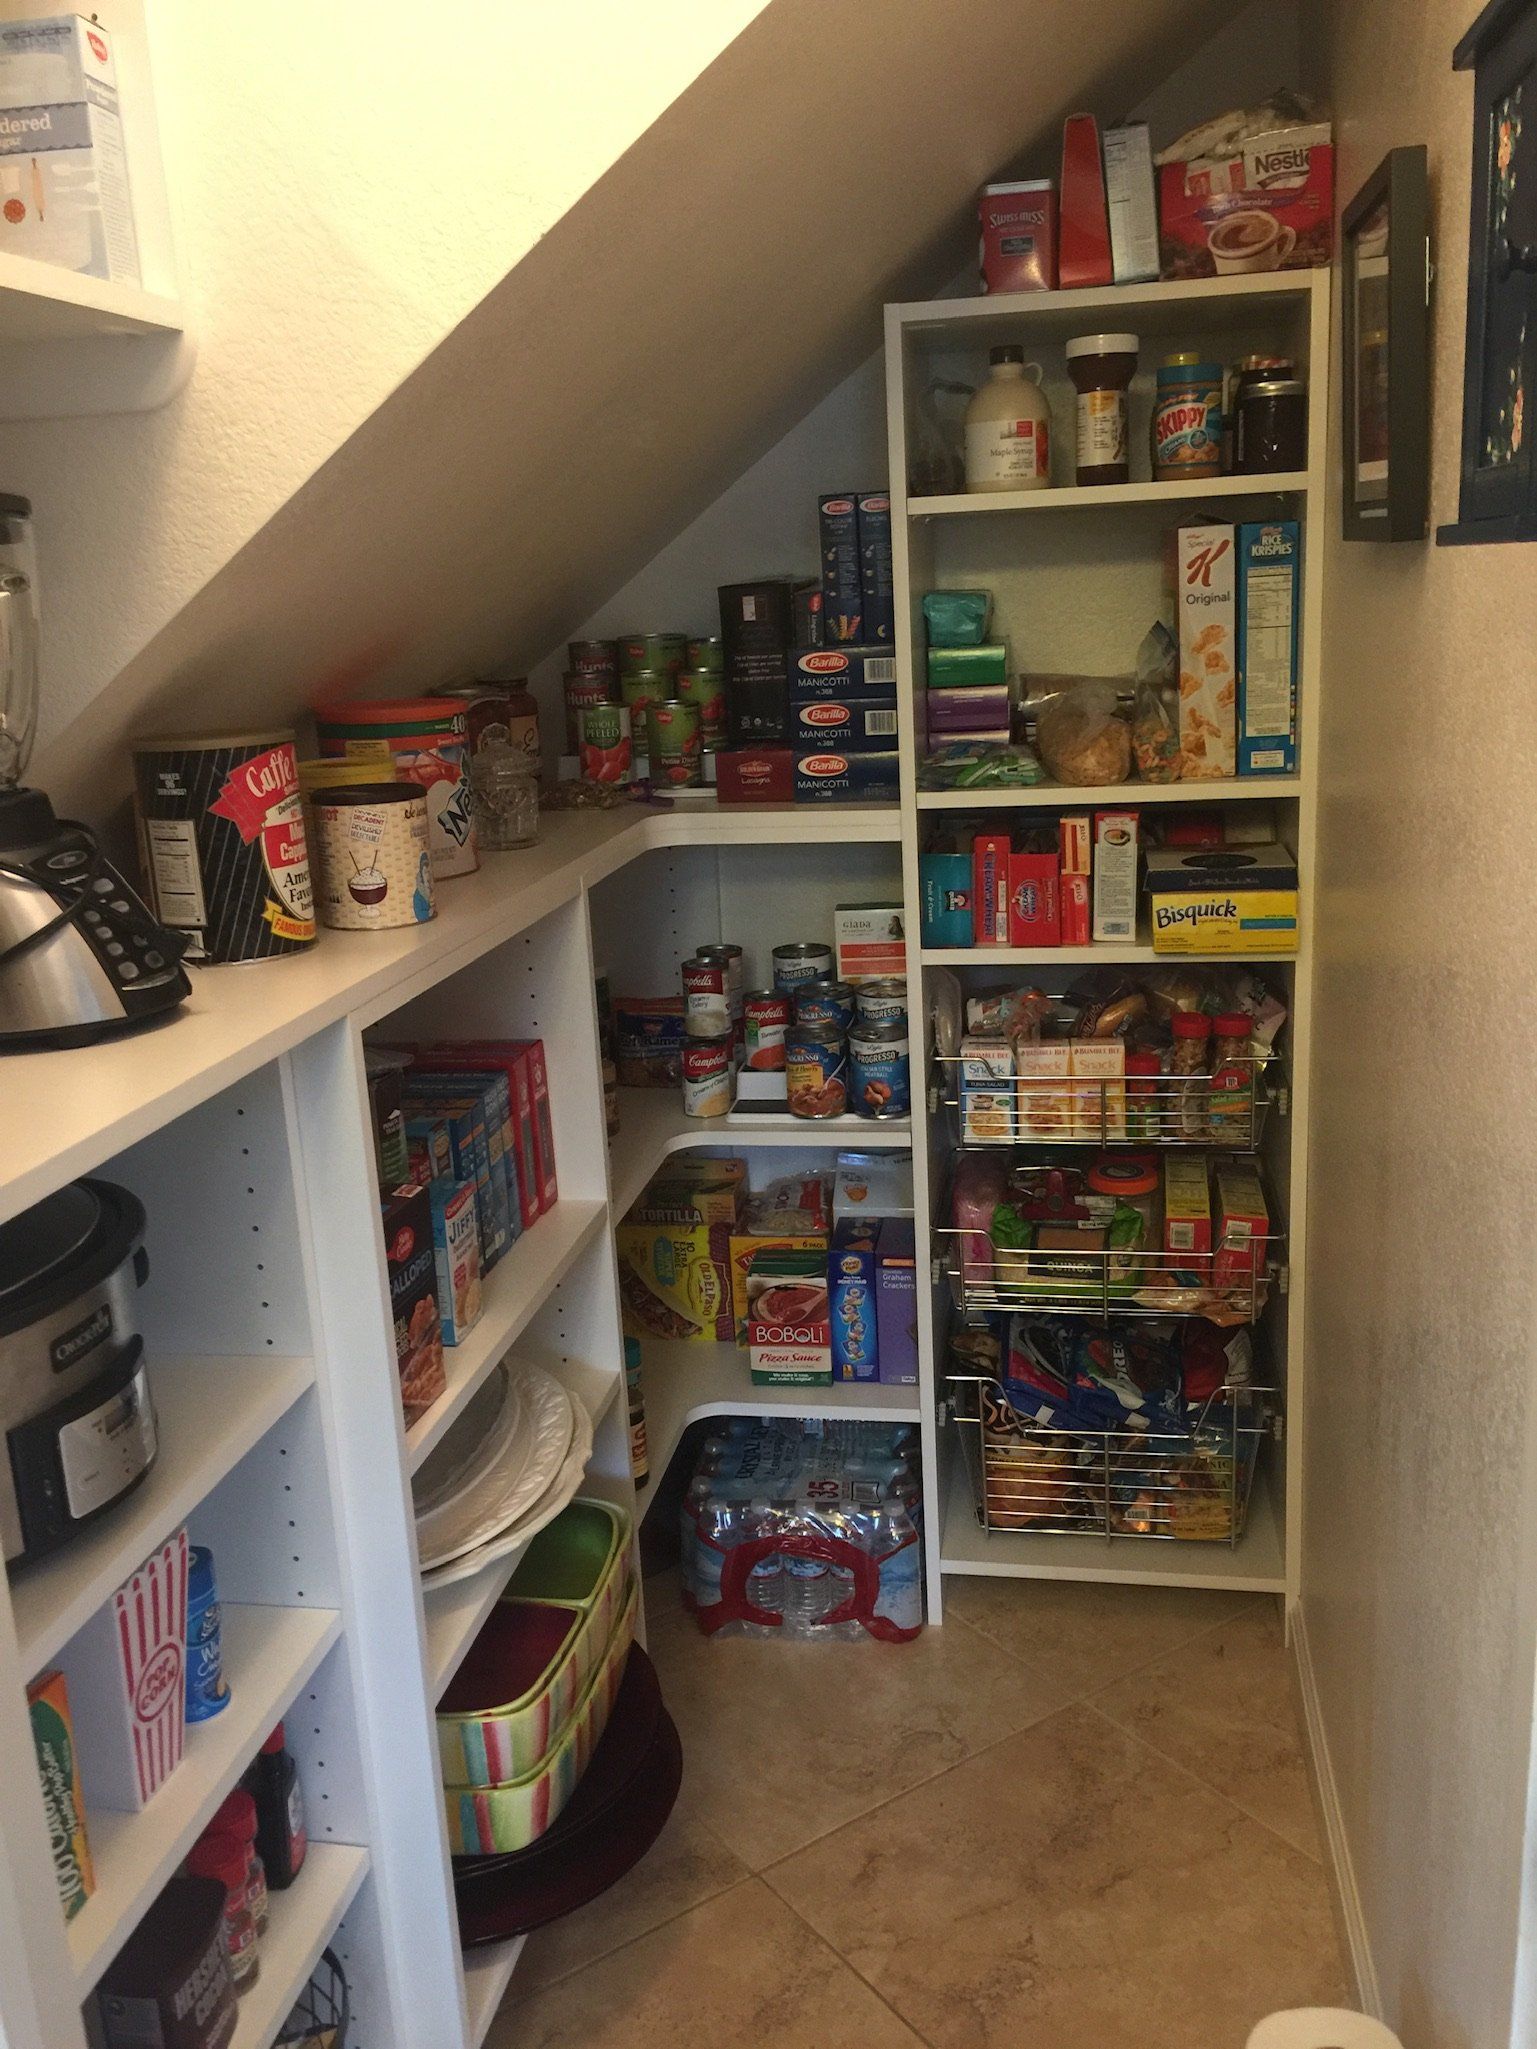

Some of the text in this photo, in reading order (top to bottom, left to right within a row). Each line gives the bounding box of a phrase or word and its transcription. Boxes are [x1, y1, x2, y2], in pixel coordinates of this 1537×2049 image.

[1156, 406, 1206, 443] SKIPPY
[990, 447, 1033, 458] Maple Syrup
[1187, 539, 1215, 549] Special
[1261, 534, 1282, 545] RICE
[1251, 543, 1293, 557] KRISPIES
[1186, 538, 1231, 587] K
[1186, 591, 1231, 606] Original
[809, 656, 845, 668] Barilla
[798, 676, 850, 687] MANICOTTI
[810, 709, 846, 721] Barilla
[450, 714, 465, 735] 40
[588, 719, 617, 728] WHOLE
[586, 727, 619, 738] PEELED
[799, 728, 851, 739] MANICOTTI
[809, 759, 844, 771] Barilla
[246, 750, 292, 798] Caffe
[798, 779, 849, 790] MANICOTTI
[353, 814, 385, 826] DECADENT
[1155, 898, 1237, 929] Bisquick
[863, 1007, 901, 1020] PROGRESSO
[857, 1051, 897, 1065] PROGRESSO
[1079, 1059, 1116, 1070] Snack
[1025, 1060, 1062, 1071] Snack
[639, 1208, 704, 1223] TORTILLA
[449, 1210, 476, 1244] JIFFY
[802, 1240, 825, 1249] 6 PACK
[679, 1241, 687, 1269] EXTRA
[391, 1249, 432, 1297] ALLOPED
[1046, 1260, 1094, 1274] QUINOA
[882, 1273, 912, 1281] Graham
[756, 1325, 824, 1344] BOBOLI
[759, 1352, 823, 1363] Pizza Sauce
[806, 1480, 839, 1499] 35
[146, 1656, 171, 1691] POP
[141, 1664, 176, 1711] CORN
